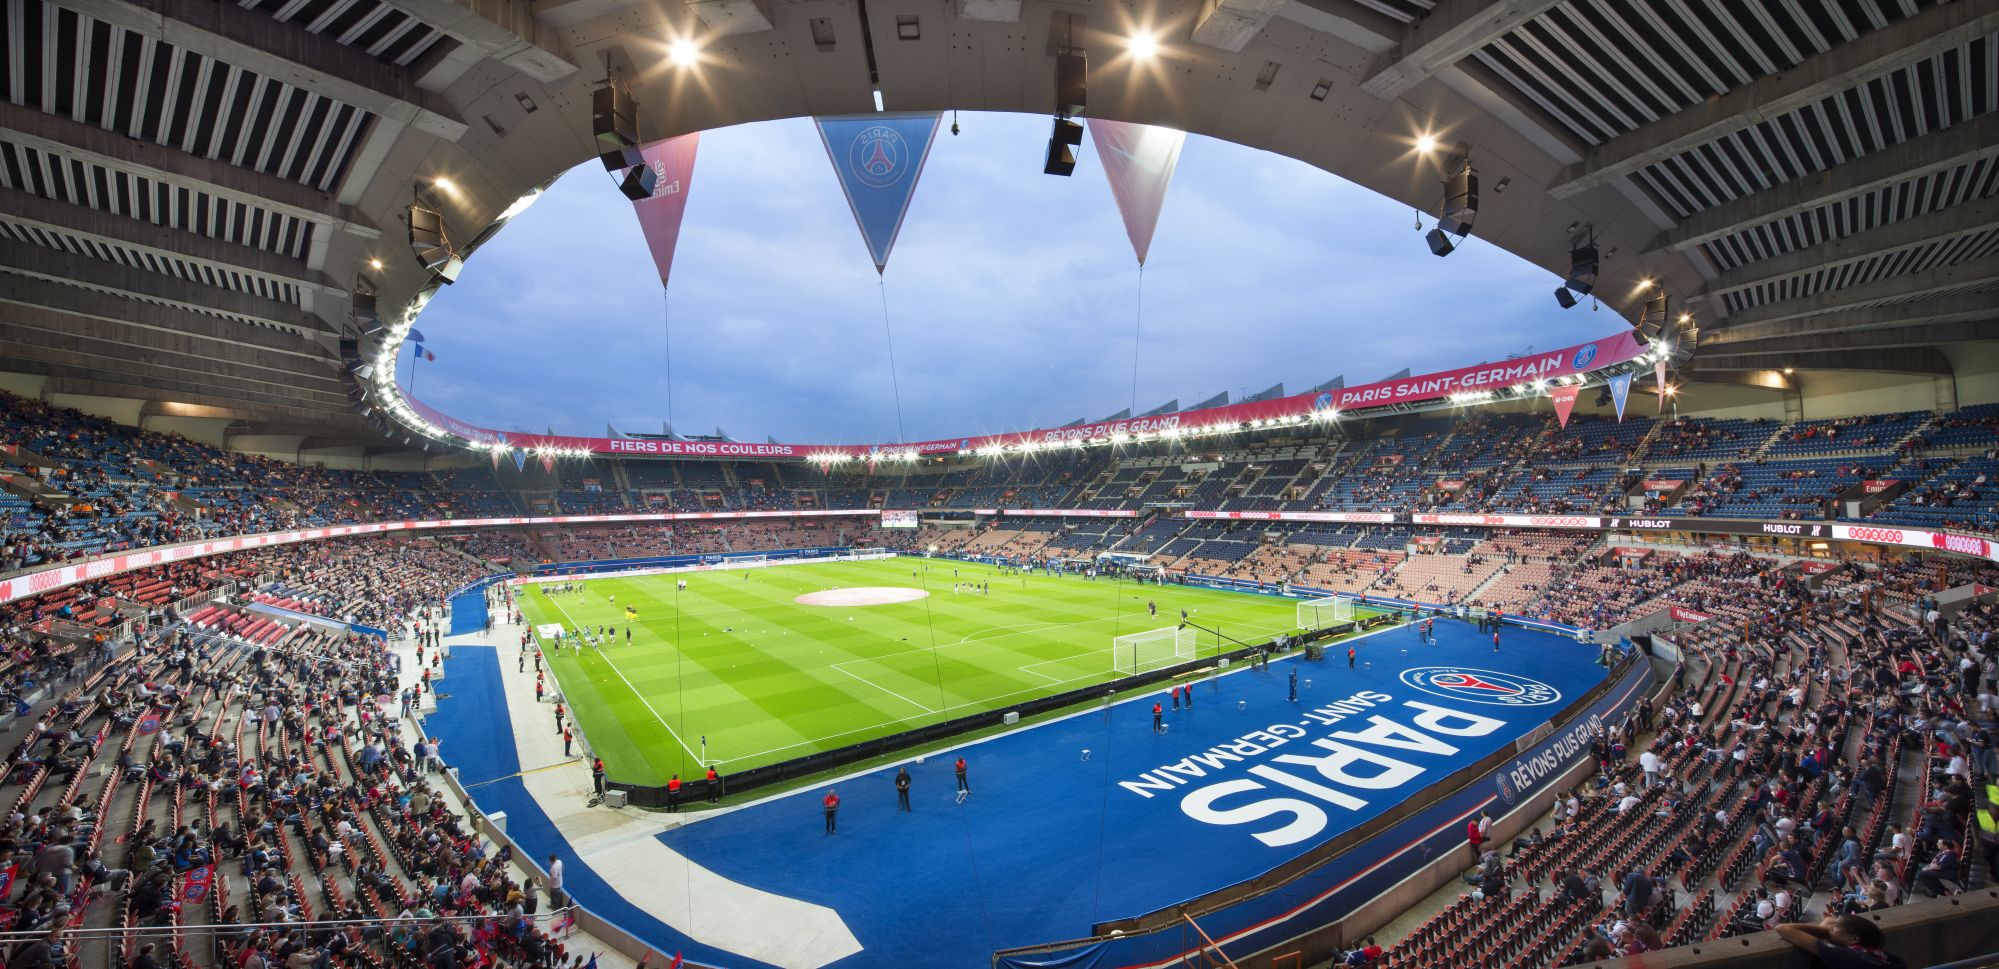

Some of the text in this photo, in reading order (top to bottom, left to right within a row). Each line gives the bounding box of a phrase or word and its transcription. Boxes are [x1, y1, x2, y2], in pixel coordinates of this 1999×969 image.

[1341, 354, 1562, 405] PARIS SAINT-GERMAIN
[1045, 416, 1180, 442] RÊVONS PLUS GRAND
[611, 440, 792, 455] FIERS DE NOS COULEURS
[883, 446, 905, 454] PARIS
[1530, 517, 1587, 528] ooredoo
[1629, 520, 1801, 534] HUBLOT HUBLOT
[1849, 527, 1903, 543] ooredoo
[1676, 609, 1685, 618] Fly
[1497, 683, 1552, 704] PARIS
[1118, 690, 1393, 798] SAINT-GERMAIN
[1511, 714, 1602, 792] RÊVONS PLUS GRAND
[1181, 701, 1507, 847] PARIS
